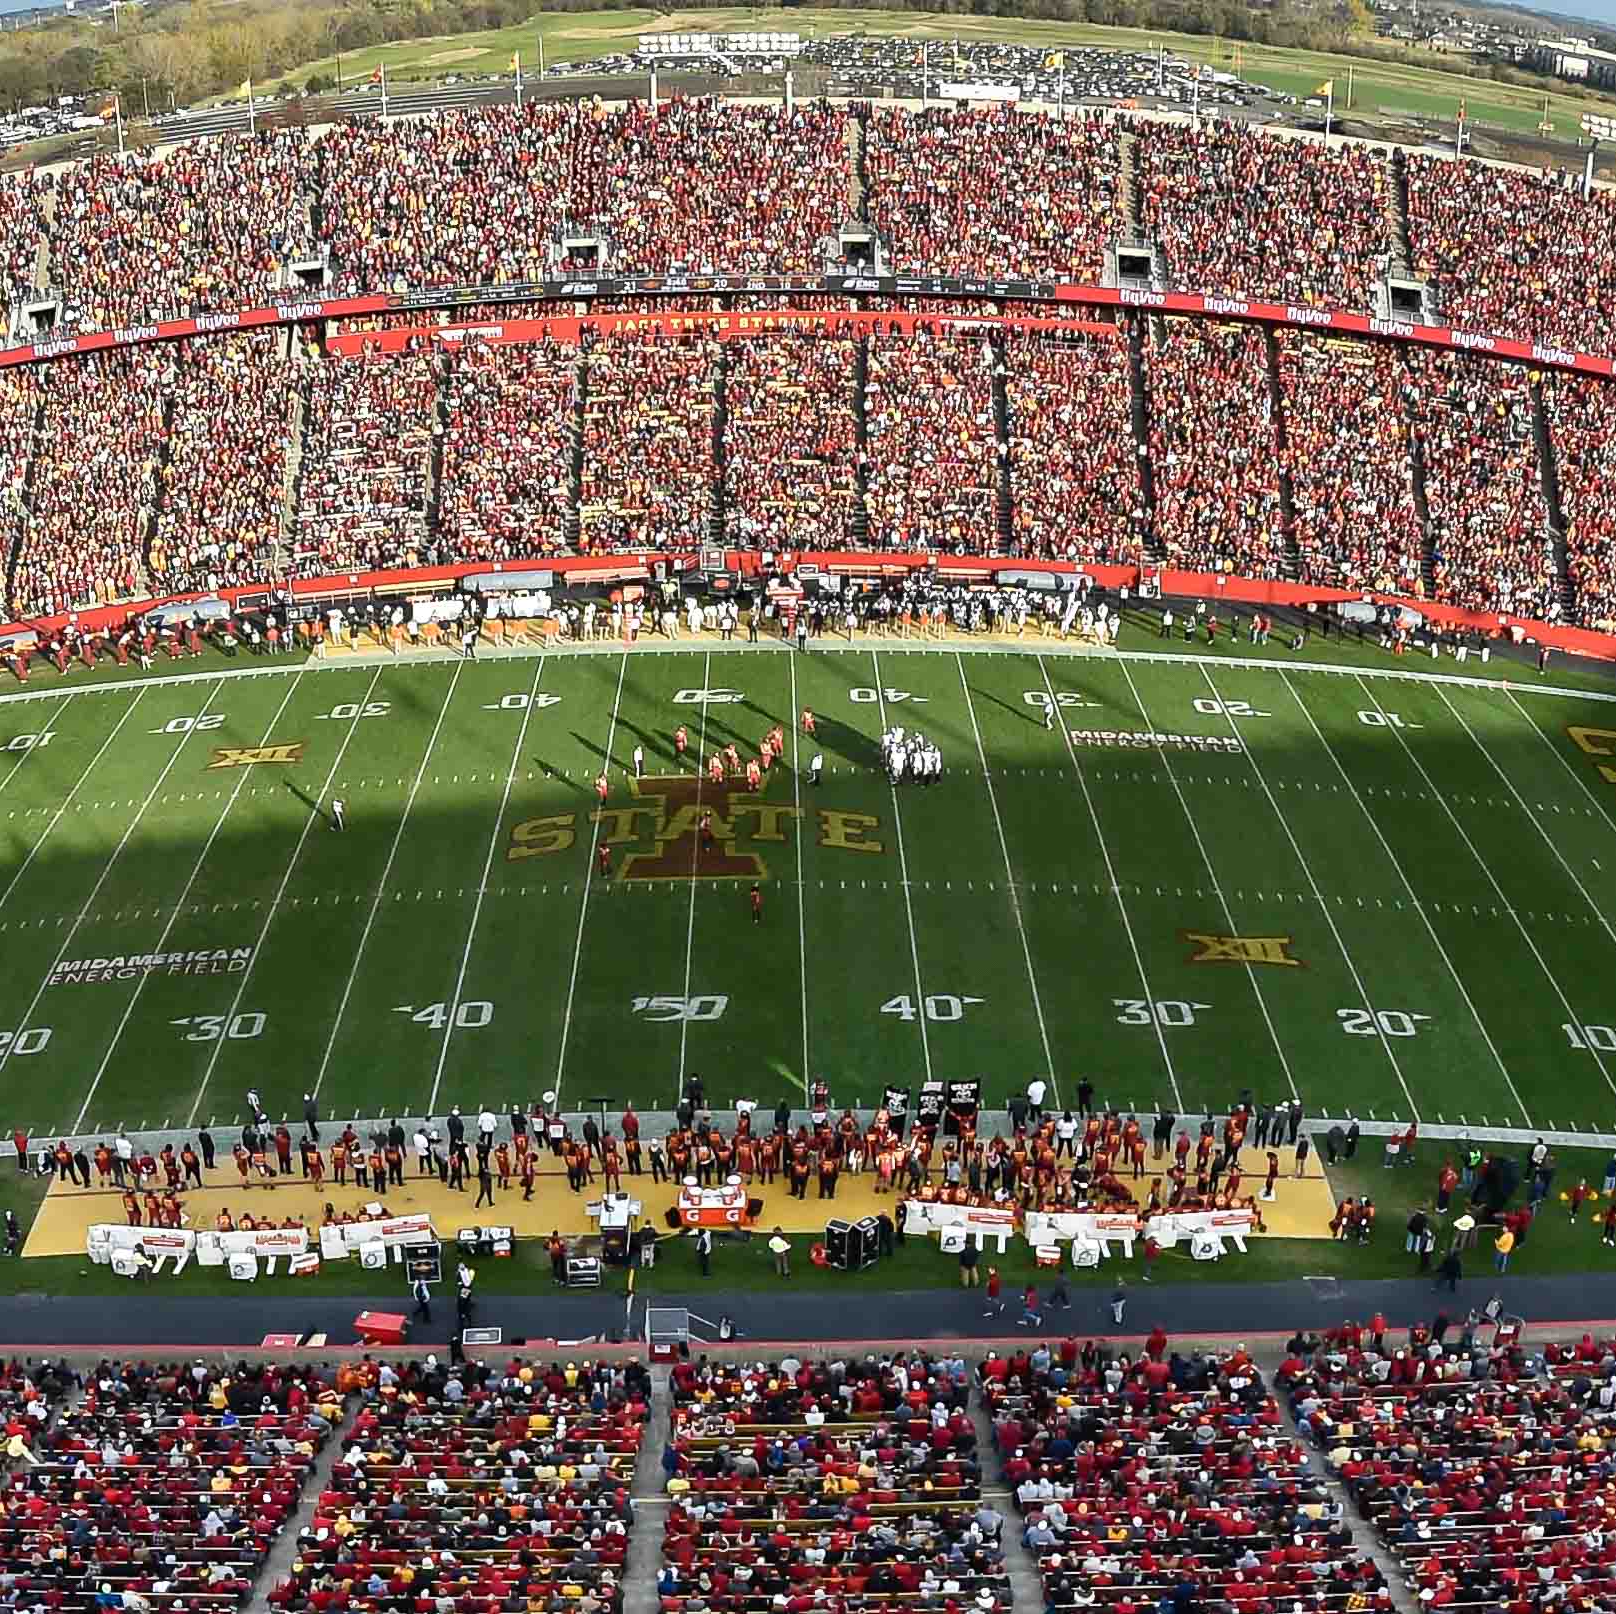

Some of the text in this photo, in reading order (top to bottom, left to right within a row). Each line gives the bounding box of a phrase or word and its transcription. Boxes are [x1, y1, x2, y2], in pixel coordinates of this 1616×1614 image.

[714, 279, 728, 288] 20
[1070, 730, 1241, 746] MIDAMERICAN
[1071, 737, 1244, 753] ENERGY FIELD
[506, 803, 884, 861] STATE
[48, 959, 249, 986] ENERGY FIELD
[55, 948, 251, 973] MIDAMERICAN
[411, 1001, 496, 1029] 40
[880, 994, 963, 1021] 40
[1115, 999, 1194, 1027] 30
[187, 1013, 267, 1041] 30
[1336, 1008, 1416, 1037] 20
[686, 1209, 700, 1222] G
[726, 1209, 740, 1222] G
